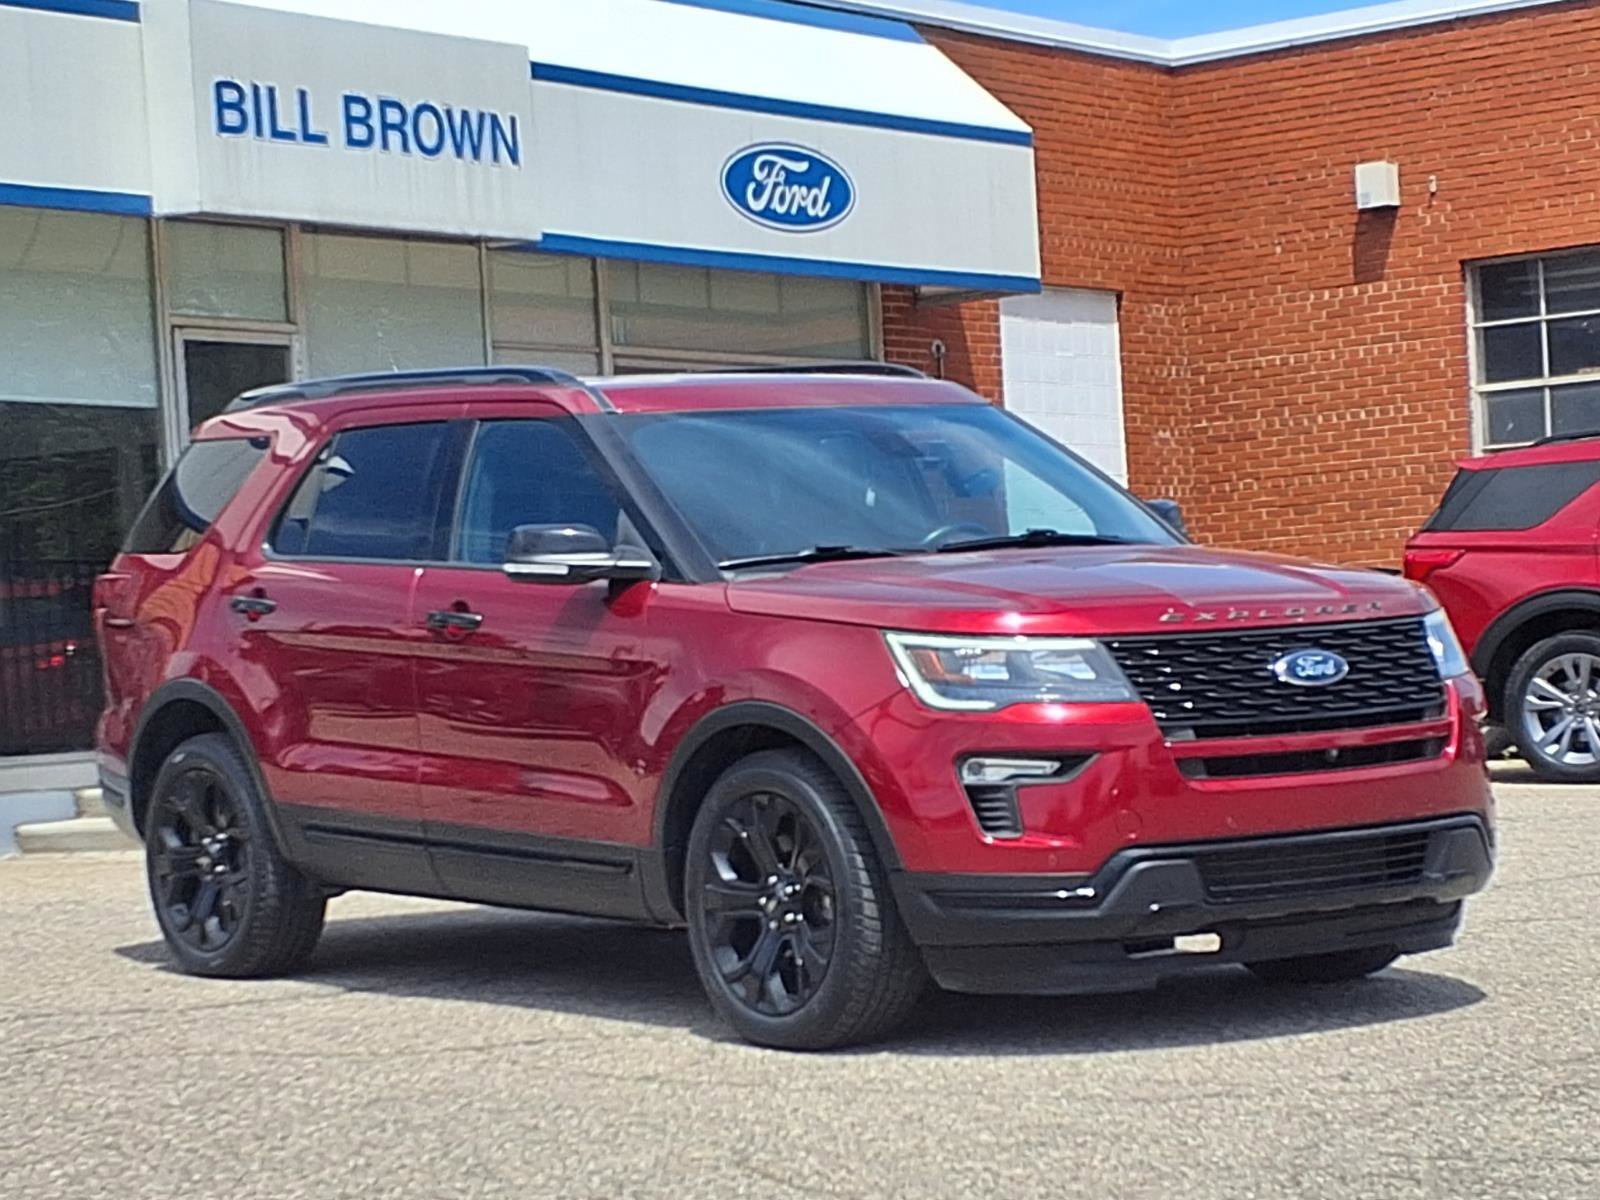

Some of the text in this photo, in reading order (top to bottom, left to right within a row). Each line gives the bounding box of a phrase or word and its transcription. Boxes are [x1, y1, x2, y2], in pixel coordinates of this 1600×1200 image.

[214, 79, 520, 168] BILL BROWN
[746, 153, 832, 218] Ford
[1158, 601, 1382, 623] EXPLORER
[1295, 655, 1336, 677] Ford
